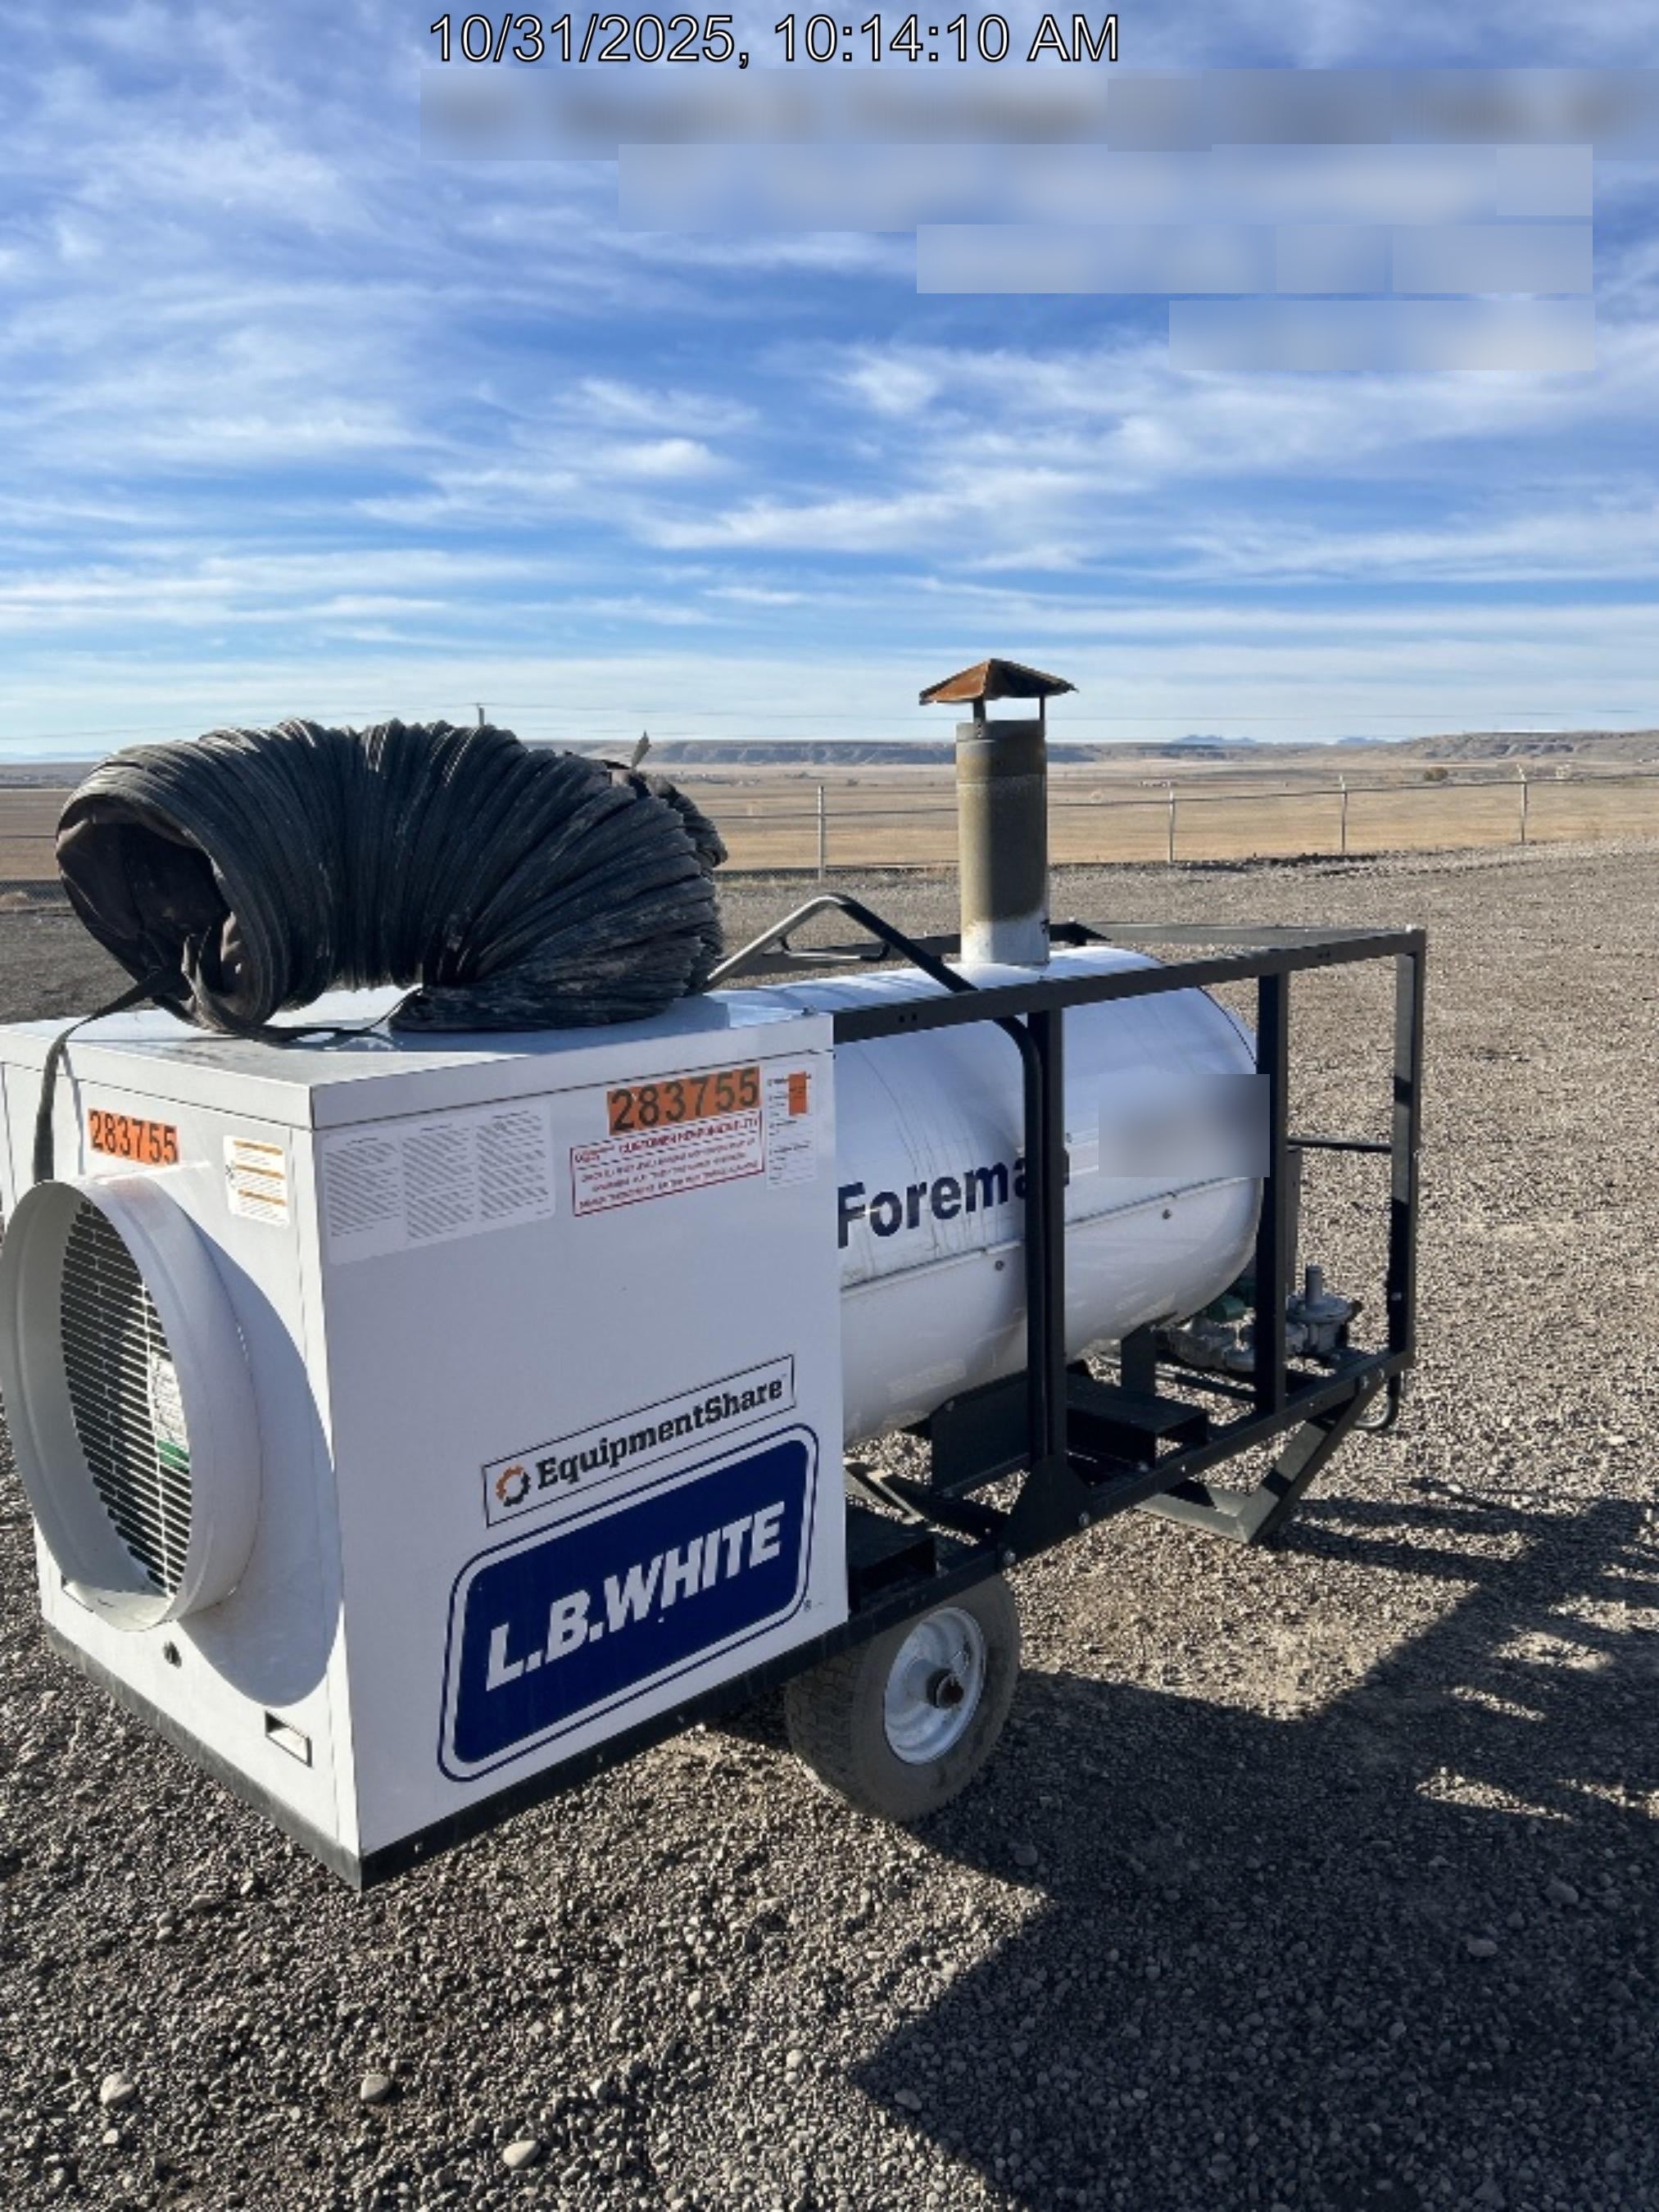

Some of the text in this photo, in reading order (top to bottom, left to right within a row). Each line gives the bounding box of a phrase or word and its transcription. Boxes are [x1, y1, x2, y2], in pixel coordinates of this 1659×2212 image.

[89, 1110, 178, 1163] 283755
[611, 1066, 759, 1131] 283755
[837, 1147, 1070, 1249] Forem
[535, 1377, 782, 1490] EquipmentShare
